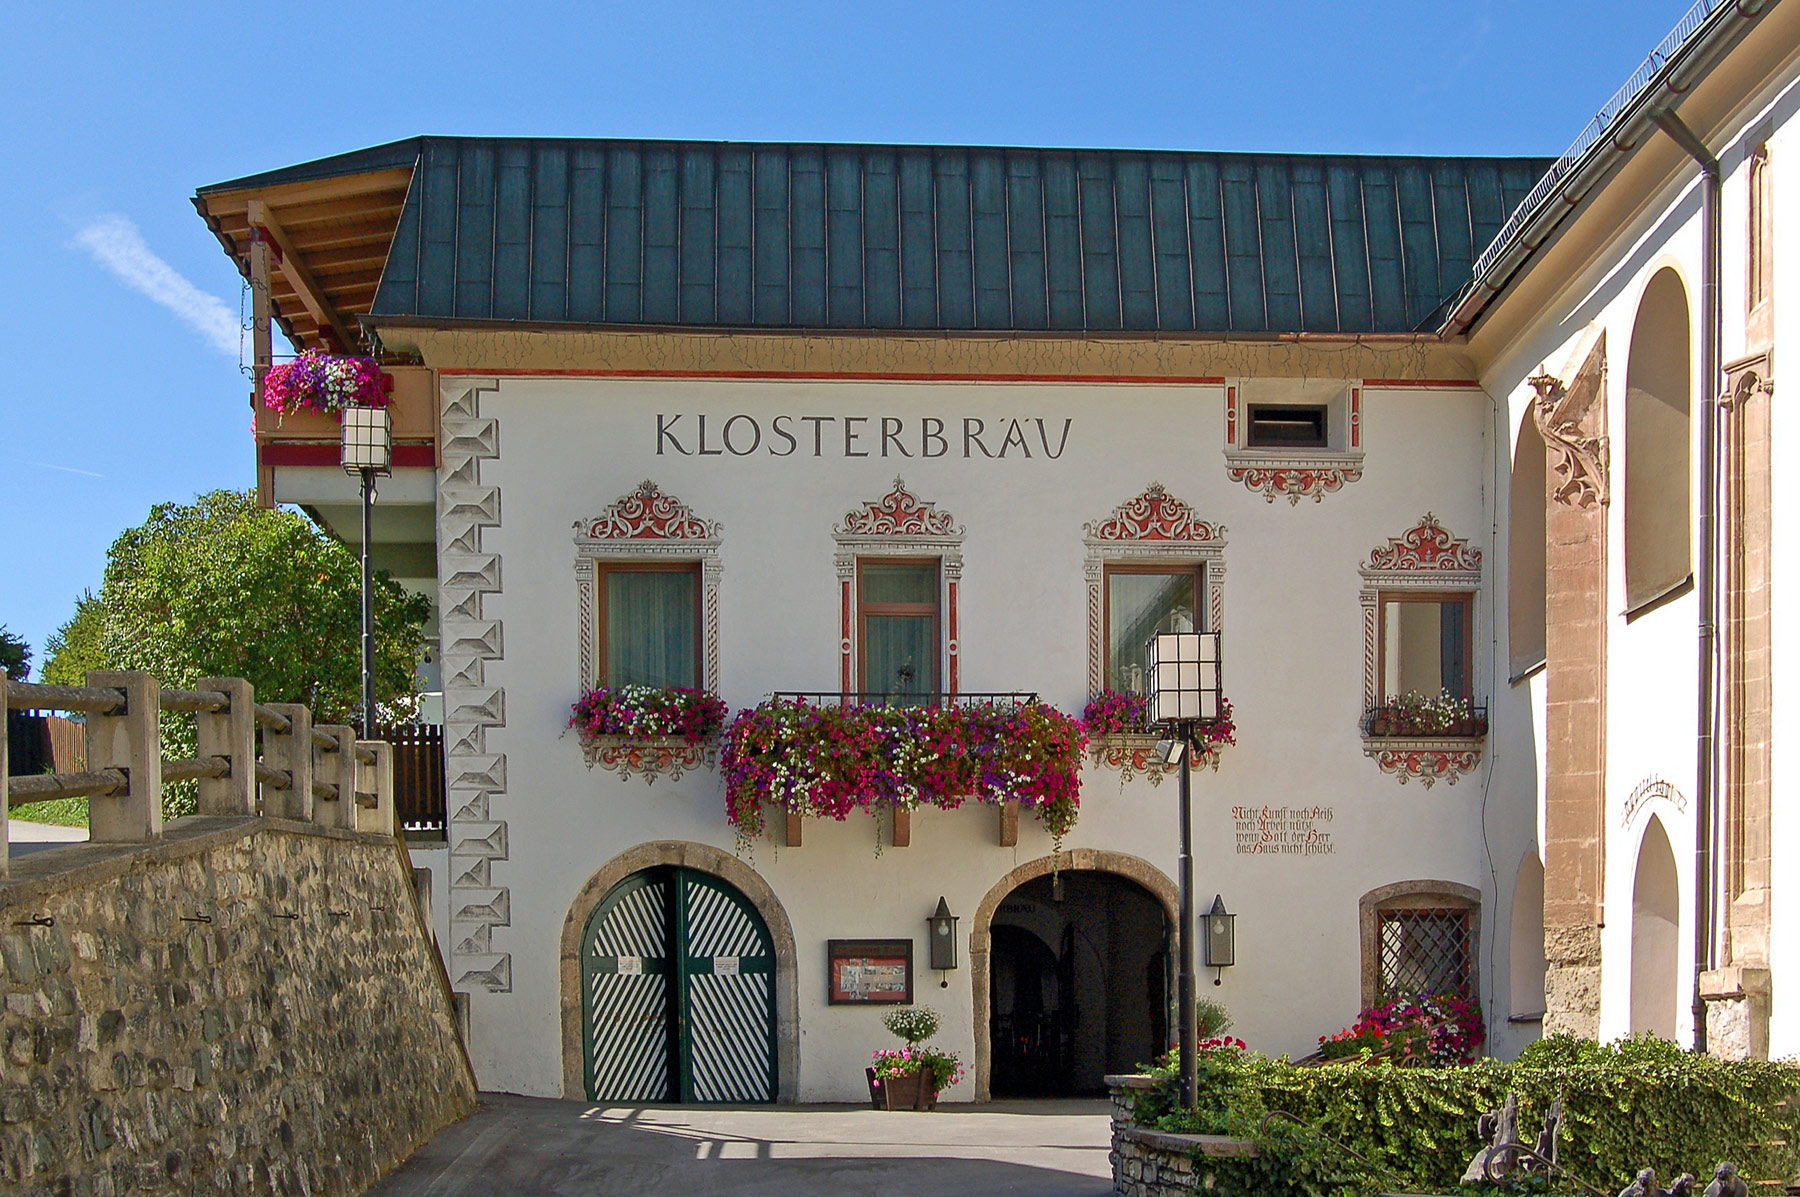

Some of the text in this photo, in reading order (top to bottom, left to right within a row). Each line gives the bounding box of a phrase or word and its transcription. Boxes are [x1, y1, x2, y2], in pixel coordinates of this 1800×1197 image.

[655, 413, 1073, 459] KLOSTERBRÄU
[1231, 806, 1258, 820] Nicht
[1290, 807, 1309, 820] noch
[1236, 820, 1256, 831] noch
[1257, 816, 1286, 831] Arbeit
[1236, 829, 1330, 842] wenn Gott der Herr
[1236, 842, 1251, 854] das
[1251, 841, 1279, 854] Haus
[1281, 842, 1303, 854] nicht
